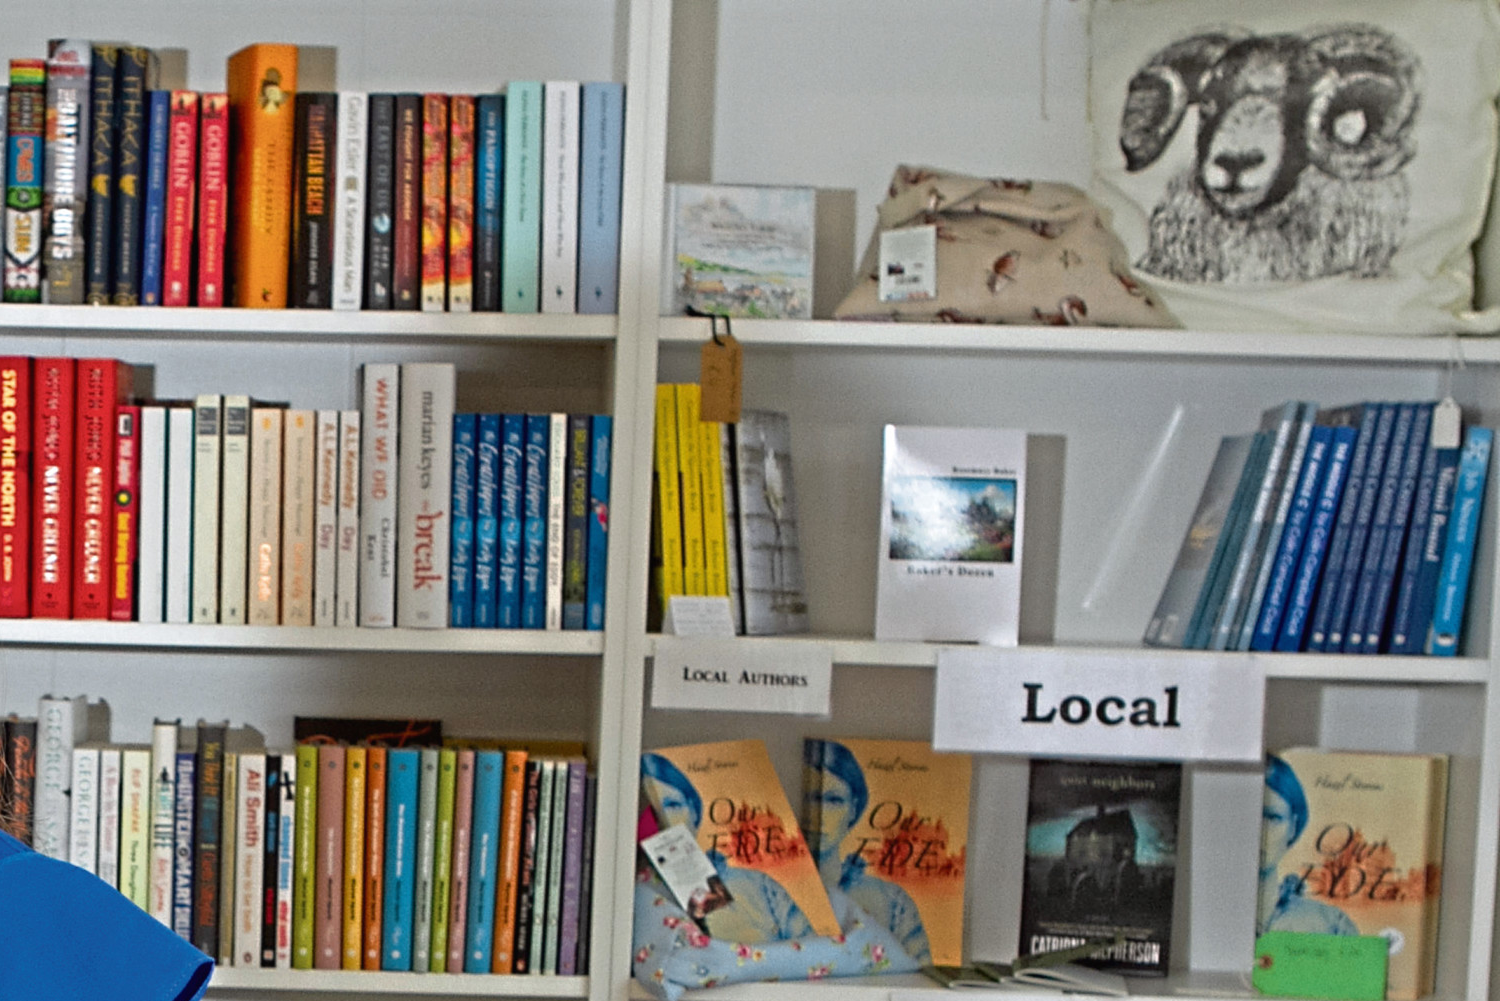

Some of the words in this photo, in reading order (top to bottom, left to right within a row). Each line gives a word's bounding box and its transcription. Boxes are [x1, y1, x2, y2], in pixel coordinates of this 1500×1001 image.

[92, 76, 112, 166] ITHACA
[120, 76, 140, 167] ITHACA
[307, 103, 326, 173] MANHATTAN
[347, 96, 366, 134] Gavin
[54, 102, 77, 203] BALTIMORE
[174, 122, 191, 188] GOBLIN
[206, 125, 223, 190] GOBLIN
[307, 177, 324, 215] BEACH
[52, 208, 74, 259] BOYS
[2, 369, 16, 408] STAR
[375, 378, 388, 429] WHAT
[2, 411, 16, 433] OF
[421, 391, 436, 445] marian
[2, 436, 16, 467] THE
[418, 447, 435, 489] keyes
[1314, 441, 1325, 457] THE
[1336, 442, 1348, 458] THE
[1, 470, 15, 527] NORTH
[44, 466, 59, 514] NEVER
[85, 466, 102, 514] NEVER
[320, 449, 333, 506] Kennedy
[342, 450, 357, 509] Kennedy
[372, 470, 387, 500] DID
[1325, 461, 1343, 496] MIDDLE
[320, 524, 332, 550] Day
[342, 526, 355, 552] Day
[1316, 512, 1329, 526] by
[43, 518, 59, 584] GREENER
[84, 519, 102, 584] GREENER
[414, 512, 444, 591] break
[1262, 606, 1280, 634] Cook
[1287, 606, 1304, 636] Cook
[683, 667, 728, 683] LOCAL
[739, 670, 808, 687] AUTHORS
[1021, 682, 1181, 728] Local
[46, 708, 63, 791] GEORGE
[79, 756, 92, 826] GEORGE
[247, 769, 260, 792] Ali
[247, 797, 260, 847] Smith
